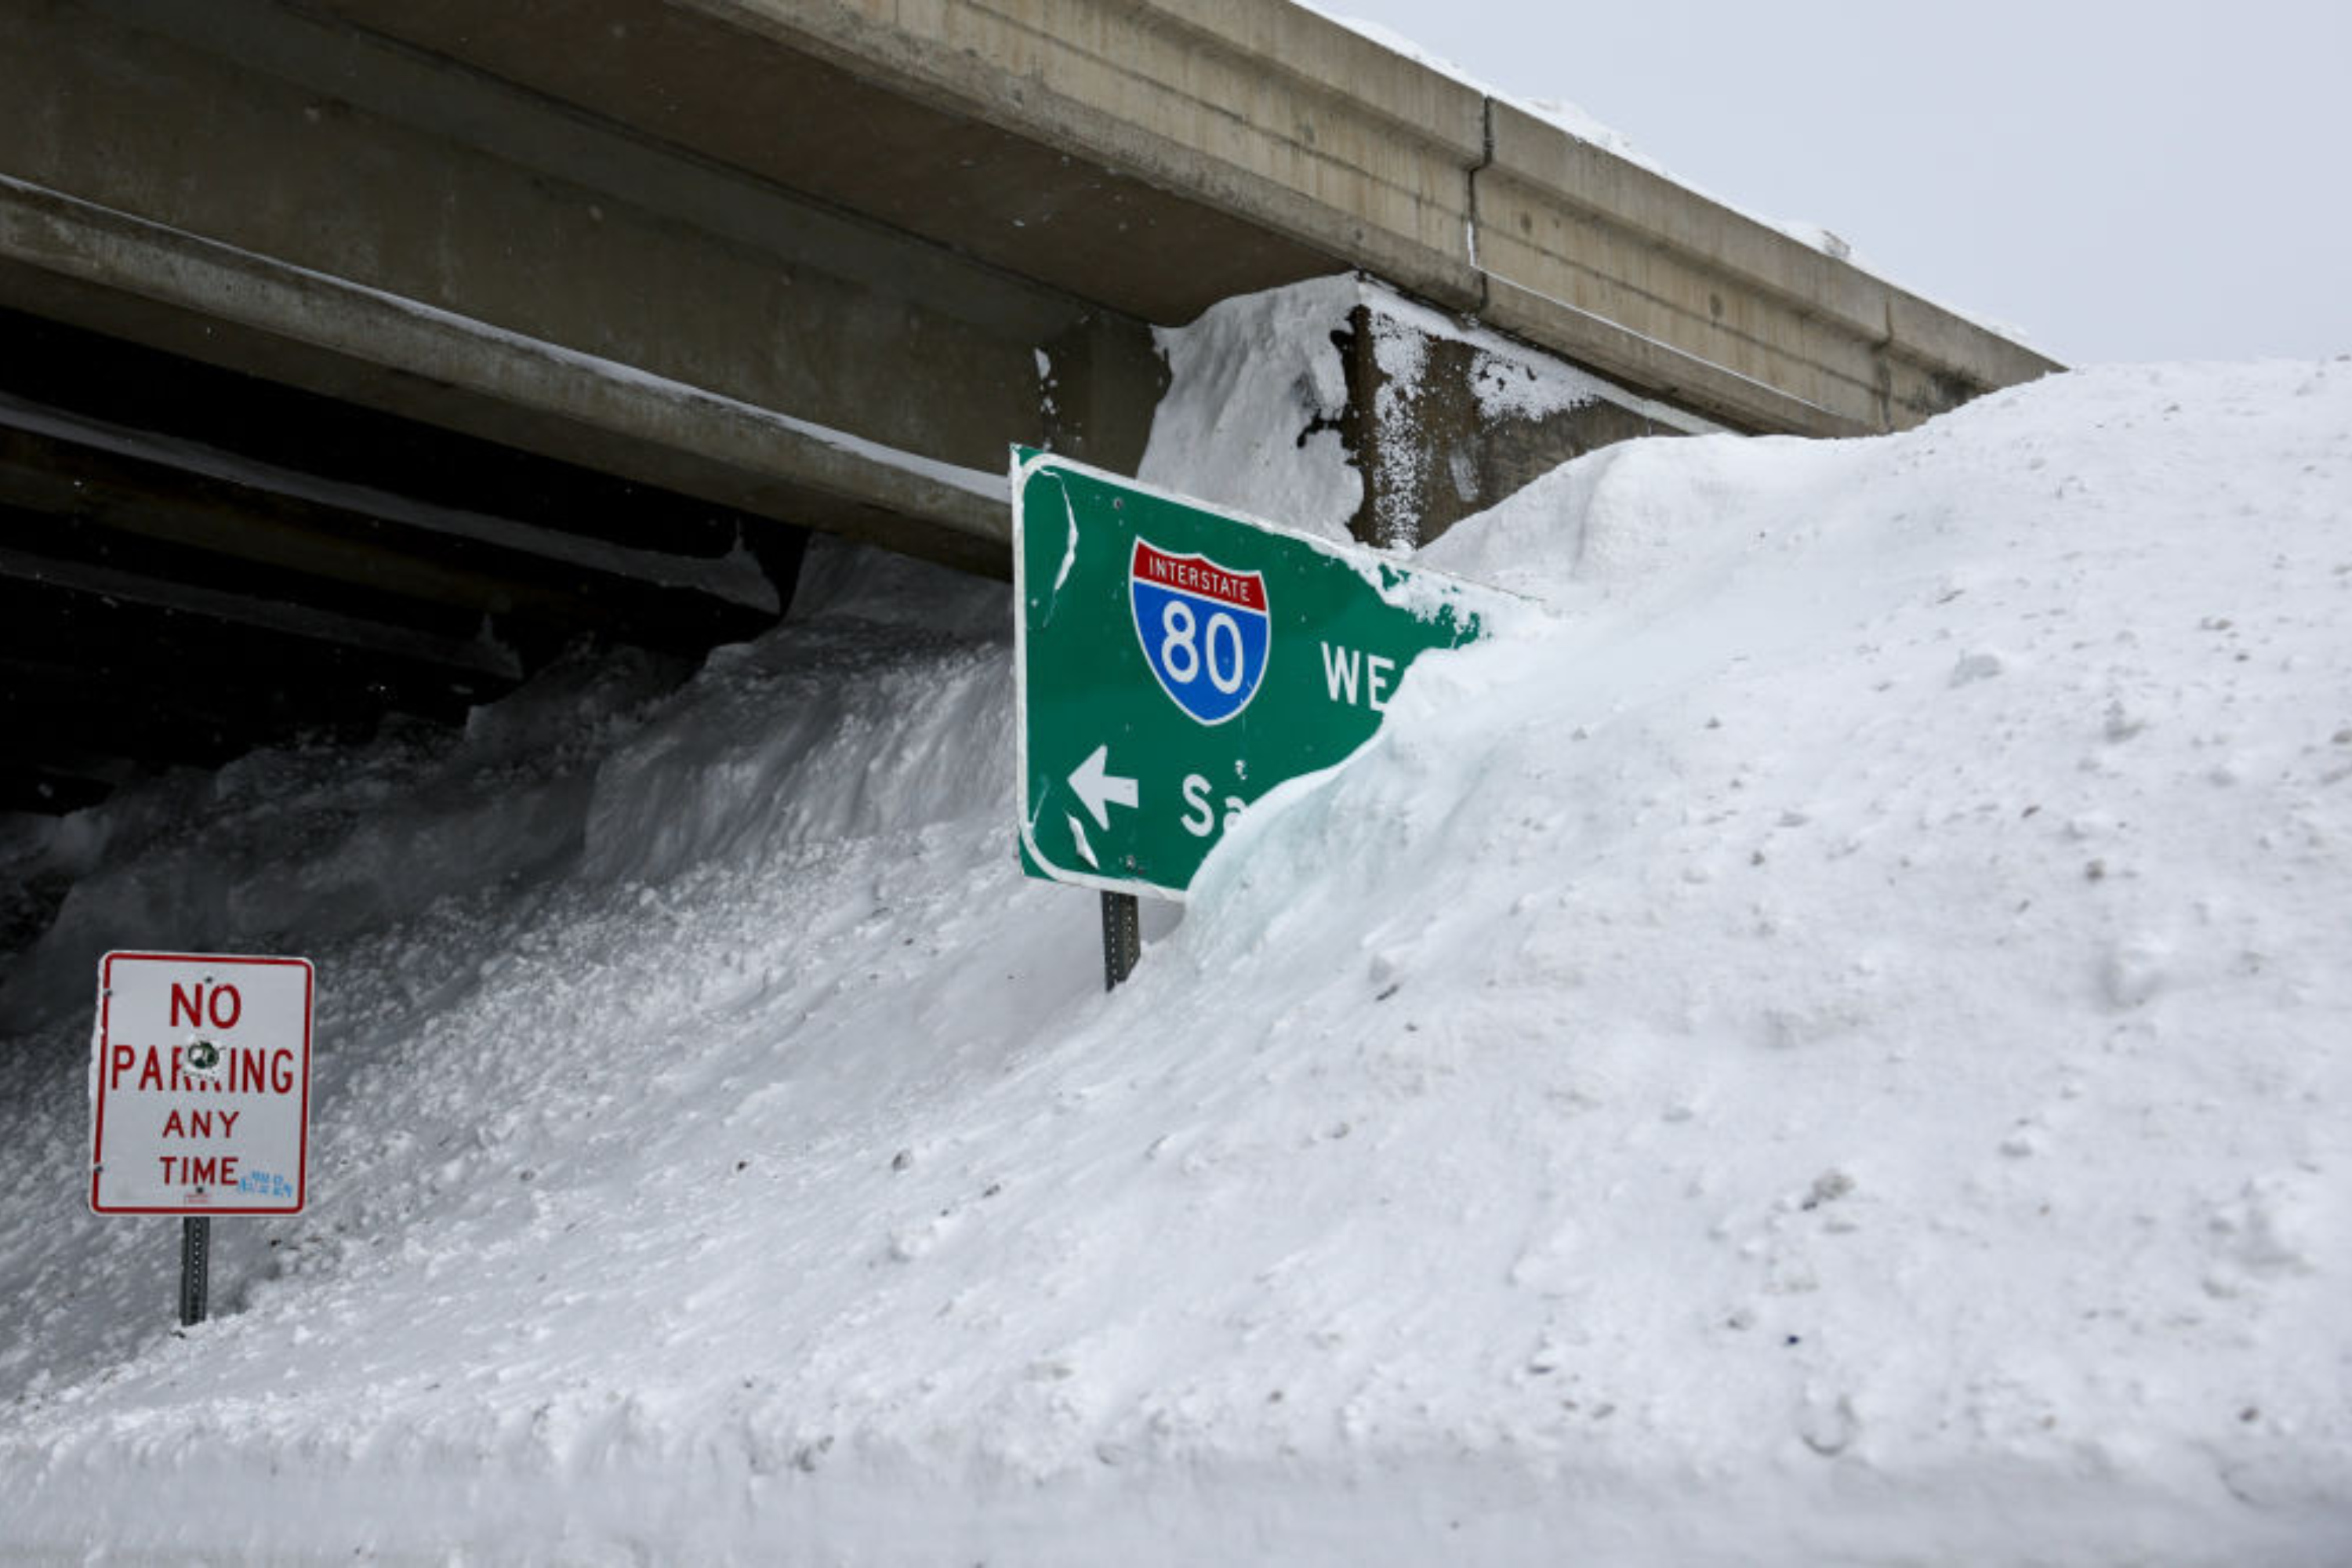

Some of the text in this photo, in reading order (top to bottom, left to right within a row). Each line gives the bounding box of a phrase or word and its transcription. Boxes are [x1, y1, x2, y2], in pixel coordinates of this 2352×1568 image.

[1149, 554, 1250, 602] INTERSTATE
[1161, 601, 1244, 695] 80
[1320, 641, 1396, 711] WE
[169, 982, 241, 1029] NO
[111, 1044, 294, 1094] PARING
[162, 1109, 240, 1138] ANY
[159, 1156, 238, 1186] TIME
